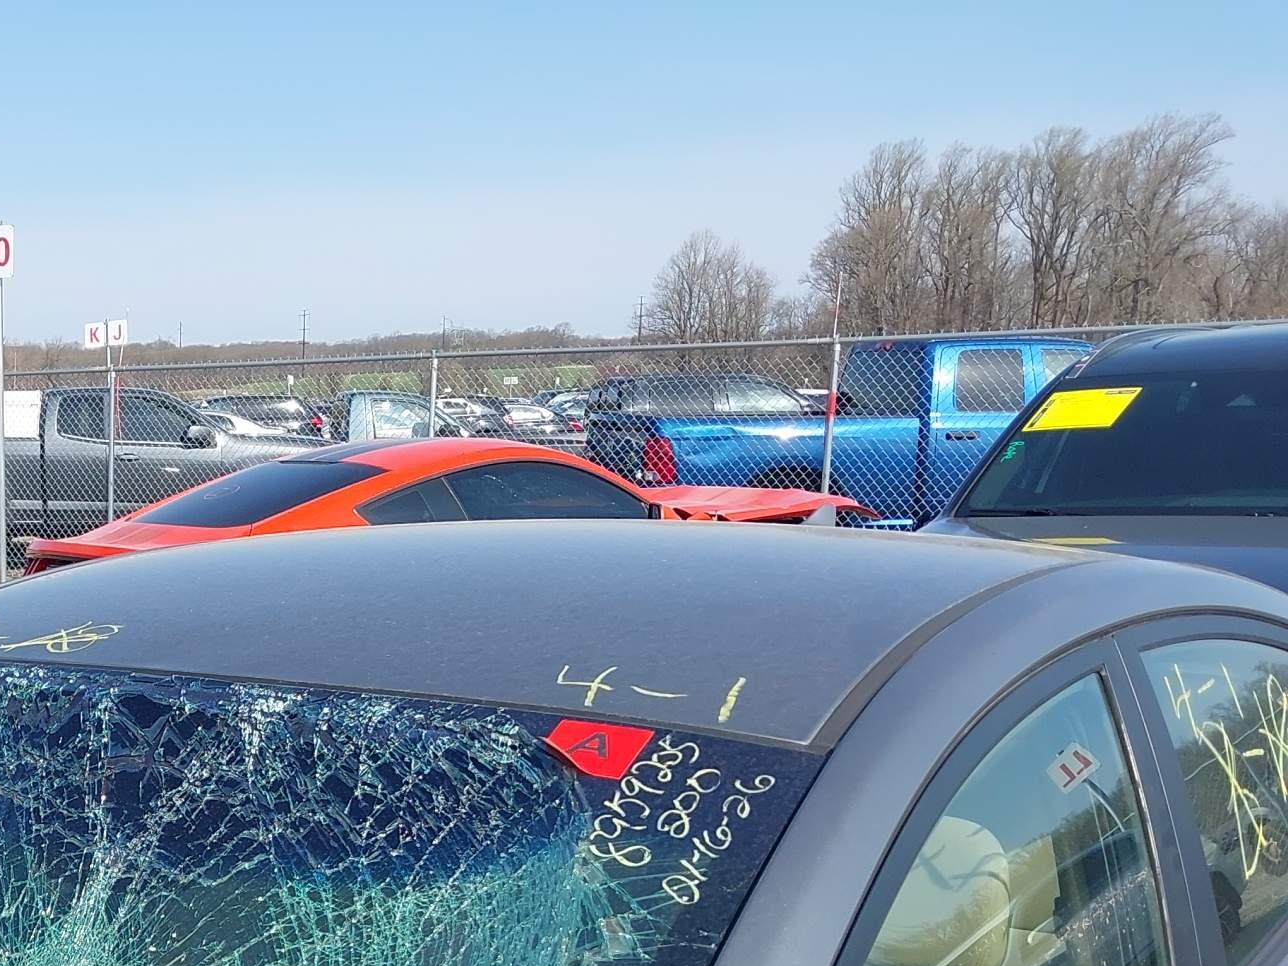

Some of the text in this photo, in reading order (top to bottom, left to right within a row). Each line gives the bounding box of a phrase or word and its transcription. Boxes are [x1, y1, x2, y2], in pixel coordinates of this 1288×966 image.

[89, 327, 100, 344] K
[113, 324, 122, 341] J
[568, 733, 609, 759] A
